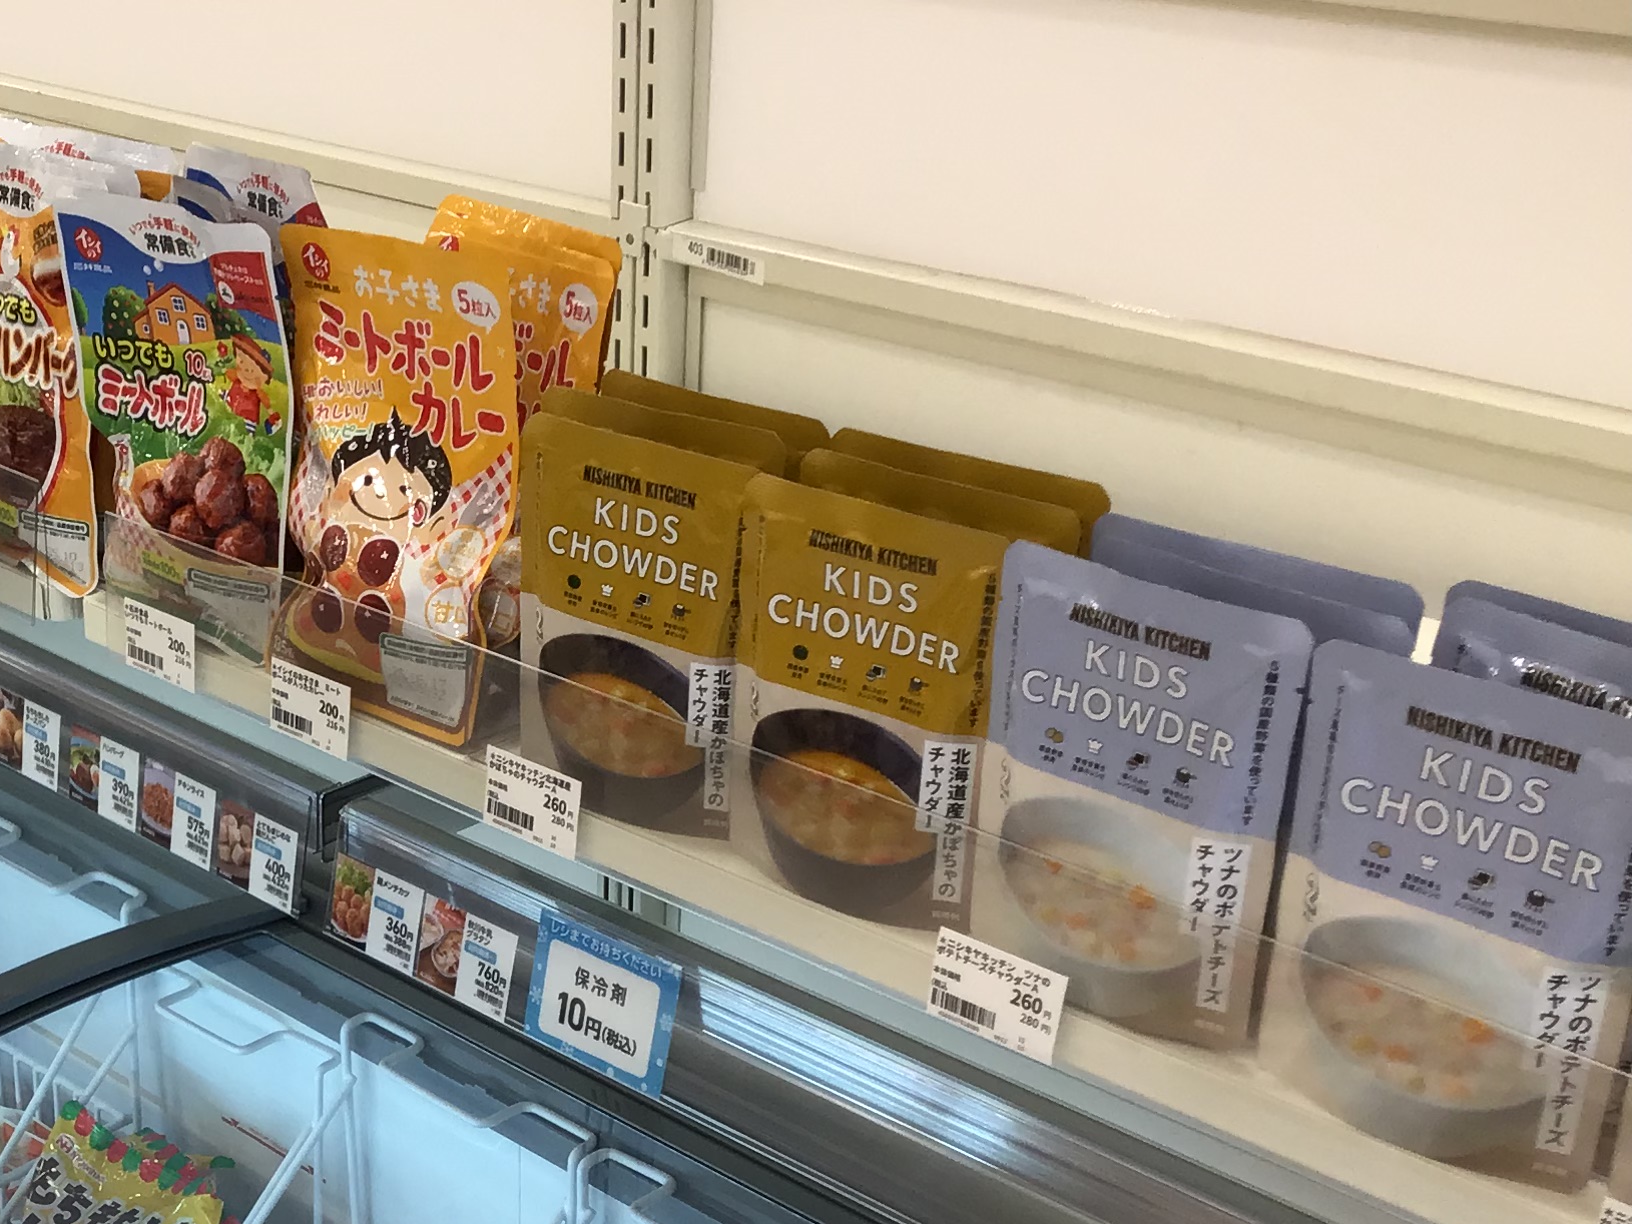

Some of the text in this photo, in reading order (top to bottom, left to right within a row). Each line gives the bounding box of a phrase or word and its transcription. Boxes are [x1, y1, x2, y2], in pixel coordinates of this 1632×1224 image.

[353, 265, 443, 313] お子さま
[457, 289, 496, 320] 5粒入
[93, 334, 174, 369] いつでも
[314, 300, 495, 393] ミートボール
[98, 364, 209, 436] ミートボール
[411, 382, 506, 450] カレー
[584, 465, 697, 510] NISHIKIYA KITCHEN
[595, 497, 680, 545] KIDS
[547, 525, 718, 601] CHOWDER
[809, 528, 938, 577] NISHIKIYA KITCHEN
[824, 563, 919, 614] KIDS
[768, 593, 961, 675] CHOWDER
[1070, 602, 1211, 661] NISHIKIYA KITCHEN
[1085, 640, 1188, 699] KIDS
[692, 668, 709, 743] チャウダー
[706, 668, 732, 807] 北海道産かぼちゃの
[1021, 668, 1235, 768] CHOWDER
[1407, 706, 1581, 774] NISHIKIYA KITCHEN
[112, 778, 134, 800] 390円
[923, 747, 945, 829] チャウダー
[1420, 746, 1550, 815] KIDS
[187, 816, 210, 839] 575円
[937, 748, 971, 898] 北海道産かぼちゃの
[1341, 777, 1603, 892] CHOWDER
[265, 858, 290, 881] 400円
[1188, 844, 1212, 935] チャウダー
[386, 917, 413, 942] 360円
[551, 918, 663, 980] レジまでお持ちください
[1204, 846, 1243, 1007] ツナのポテトチーズ
[478, 961, 507, 989] 760円
[575, 965, 628, 1008] 保冷剤
[1024, 969, 1051, 987] ツナの
[557, 991, 637, 1058] 10円(税込)
[1535, 974, 1570, 1069] チャウダー
[1545, 975, 1602, 1147] ツナのポテトチーズ
